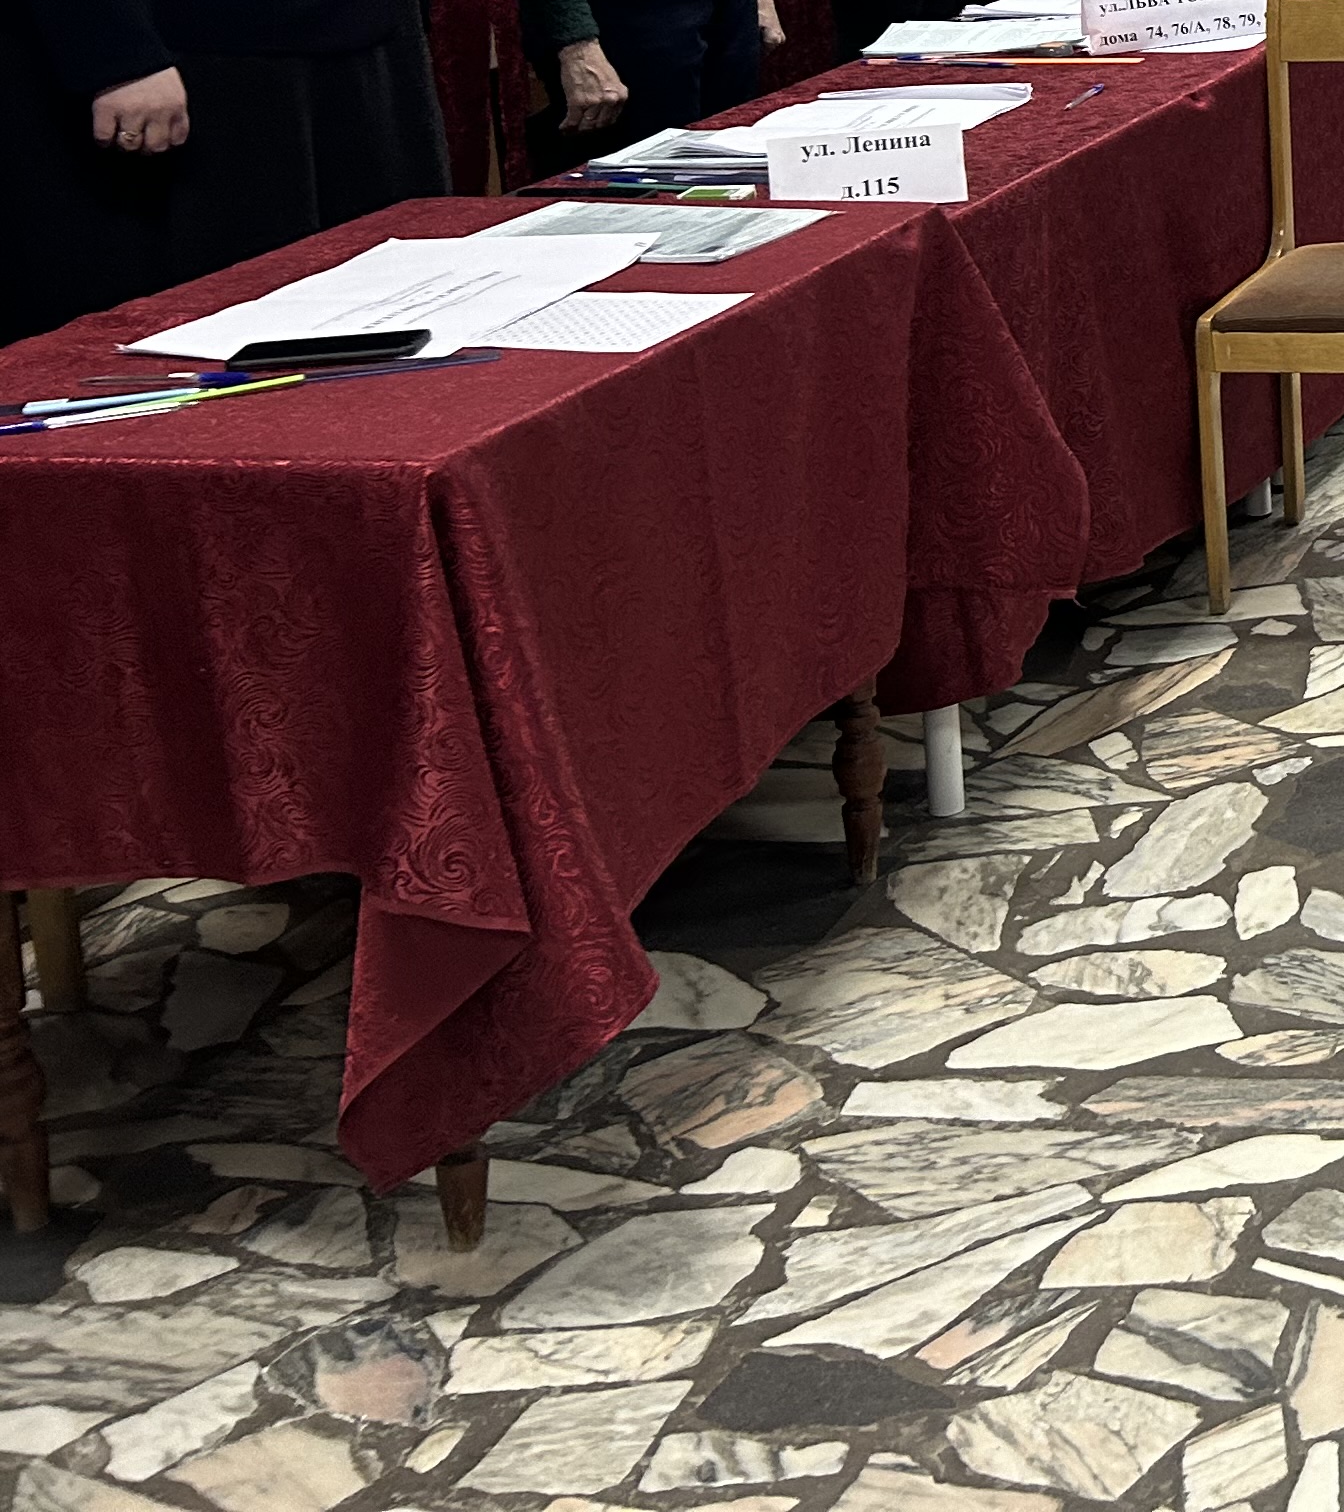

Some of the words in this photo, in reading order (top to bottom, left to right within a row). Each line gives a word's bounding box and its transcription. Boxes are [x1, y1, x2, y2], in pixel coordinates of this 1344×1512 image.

[1100, 32, 1138, 46] дома
[1146, 26, 1169, 39] 74,
[1172, 21, 1211, 36] 76/А,
[1214, 17, 1236, 30] 78,
[1239, 14, 1261, 27] 79,
[800, 143, 835, 163] ул.
[841, 134, 931, 154] Ленина
[841, 177, 900, 200] д.115
